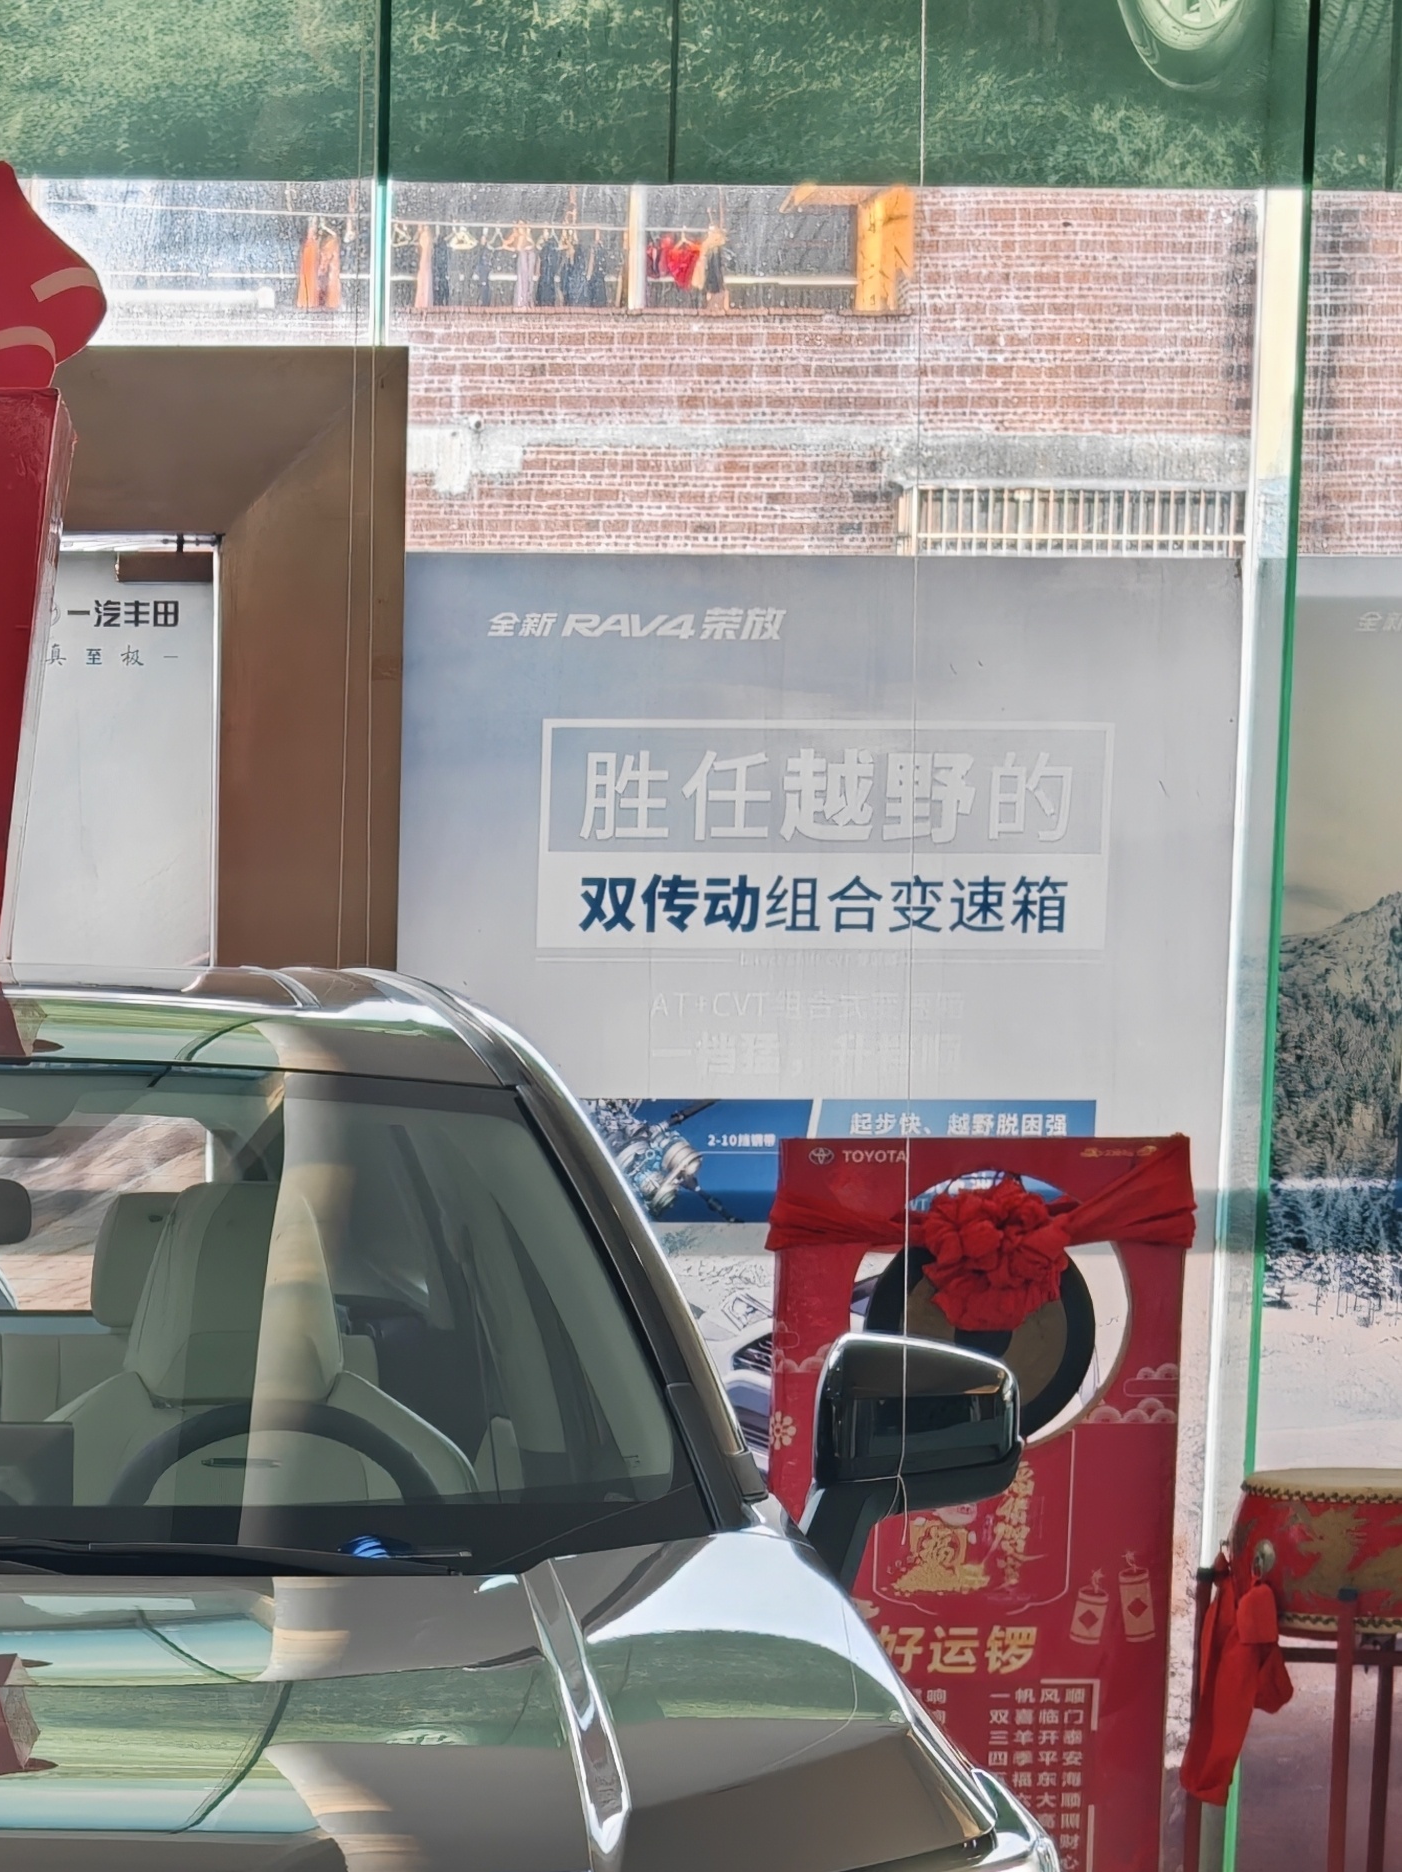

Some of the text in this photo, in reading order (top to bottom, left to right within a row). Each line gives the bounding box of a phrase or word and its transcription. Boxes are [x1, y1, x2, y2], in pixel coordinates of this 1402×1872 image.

[67, 600, 179, 627] 一汽丰田
[578, 747, 1074, 845] 胜任越野的
[579, 875, 1069, 936] 双传动组合变速箱
[849, 1112, 1068, 1137] 起步快、越野脱困强
[843, 1149, 906, 1164] TOYOTA
[879, 1625, 1038, 1674] 好运锣
[989, 1688, 1086, 1704] 一帆风顺
[989, 1708, 1084, 1725] 双喜临门
[988, 1730, 1083, 1746] 三羊开泰
[988, 1750, 1083, 1767] 四季平安
